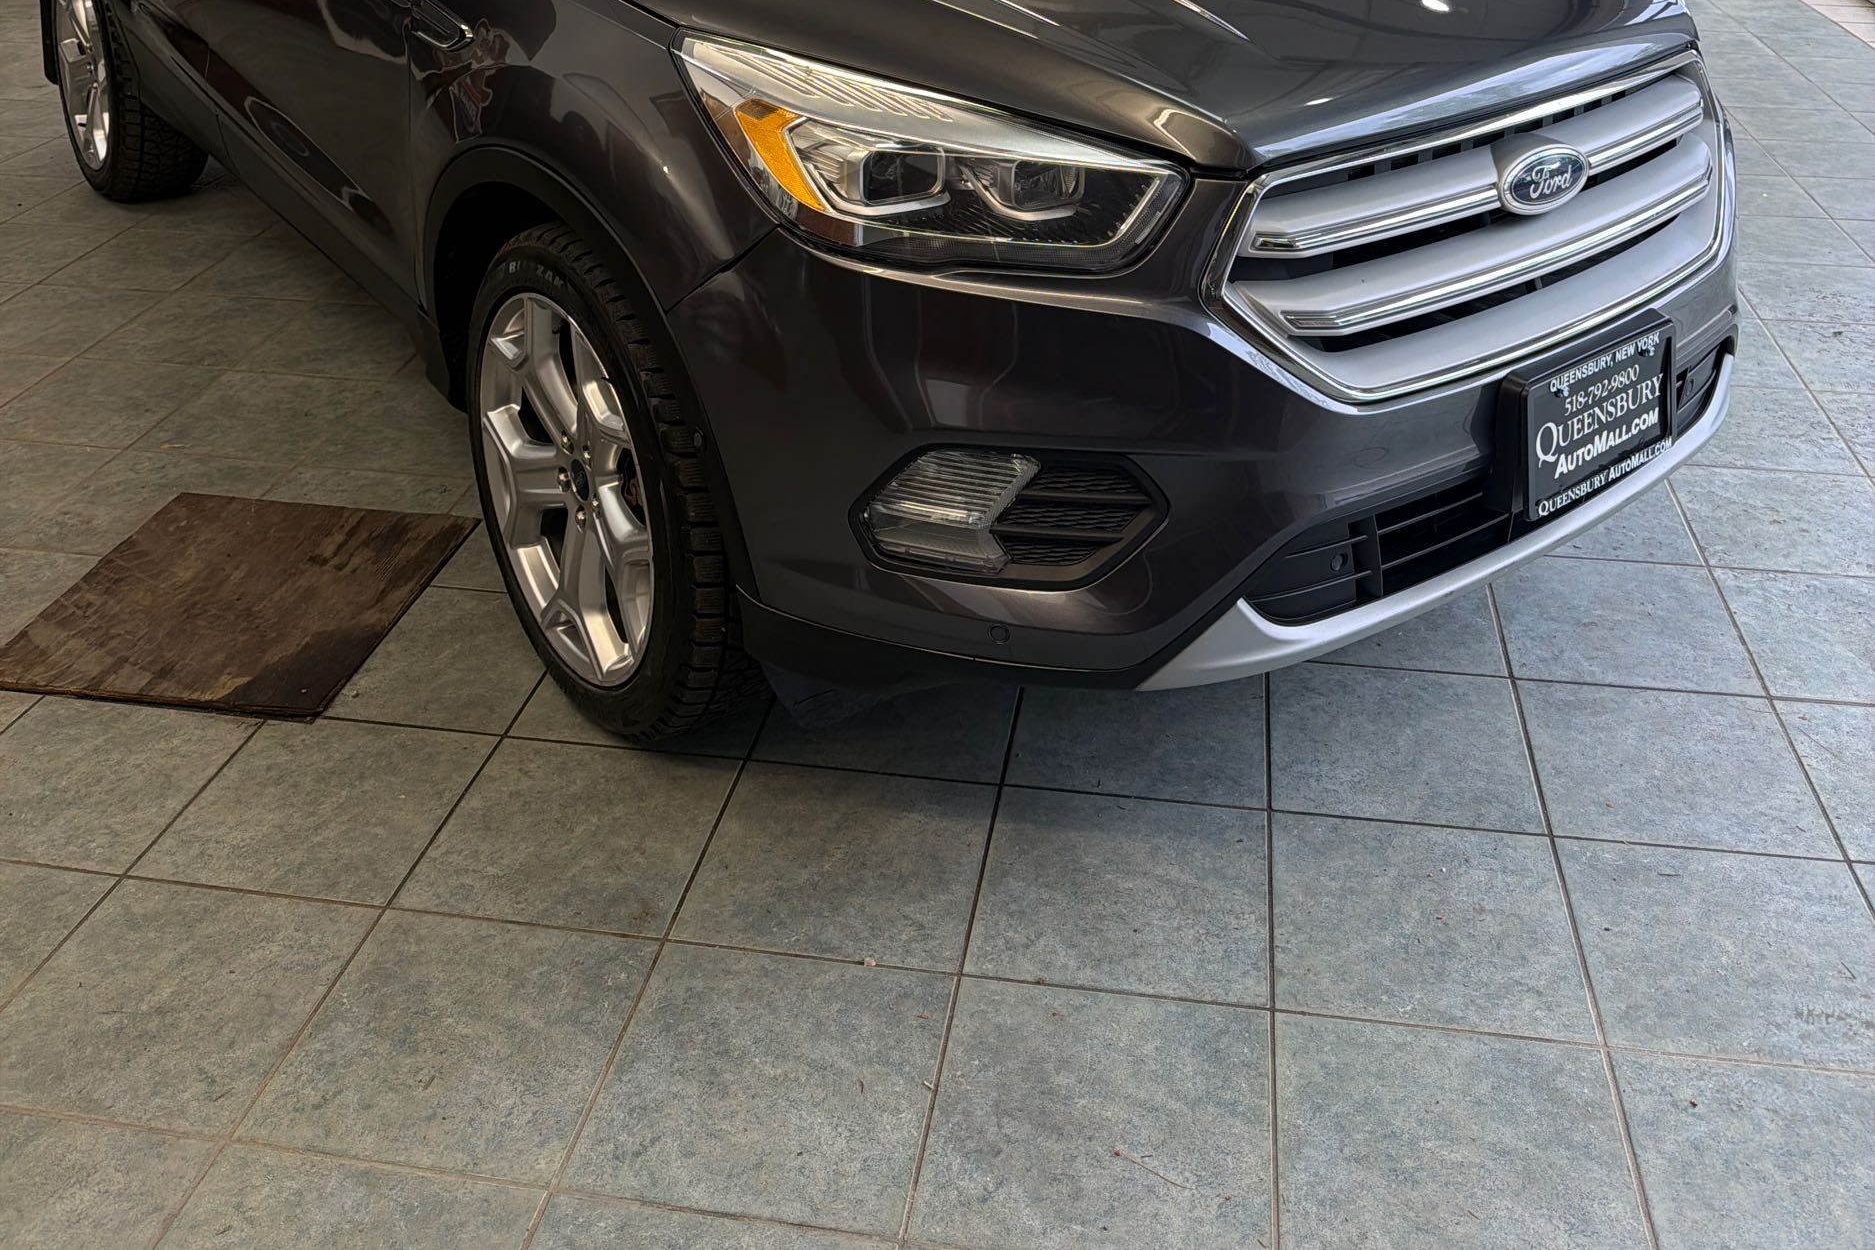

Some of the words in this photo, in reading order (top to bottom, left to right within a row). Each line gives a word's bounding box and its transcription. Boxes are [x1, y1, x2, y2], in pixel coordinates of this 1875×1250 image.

[1529, 161, 1573, 199] Ford
[1549, 356, 1614, 393] QUEENSBURY,
[1615, 343, 1636, 363] NEW
[1637, 331, 1660, 351] YORK
[1564, 364, 1640, 416] 518-792-9800
[1535, 372, 1664, 469] QUEENSBURY
[1538, 470, 1609, 517] QUEENSBURY
